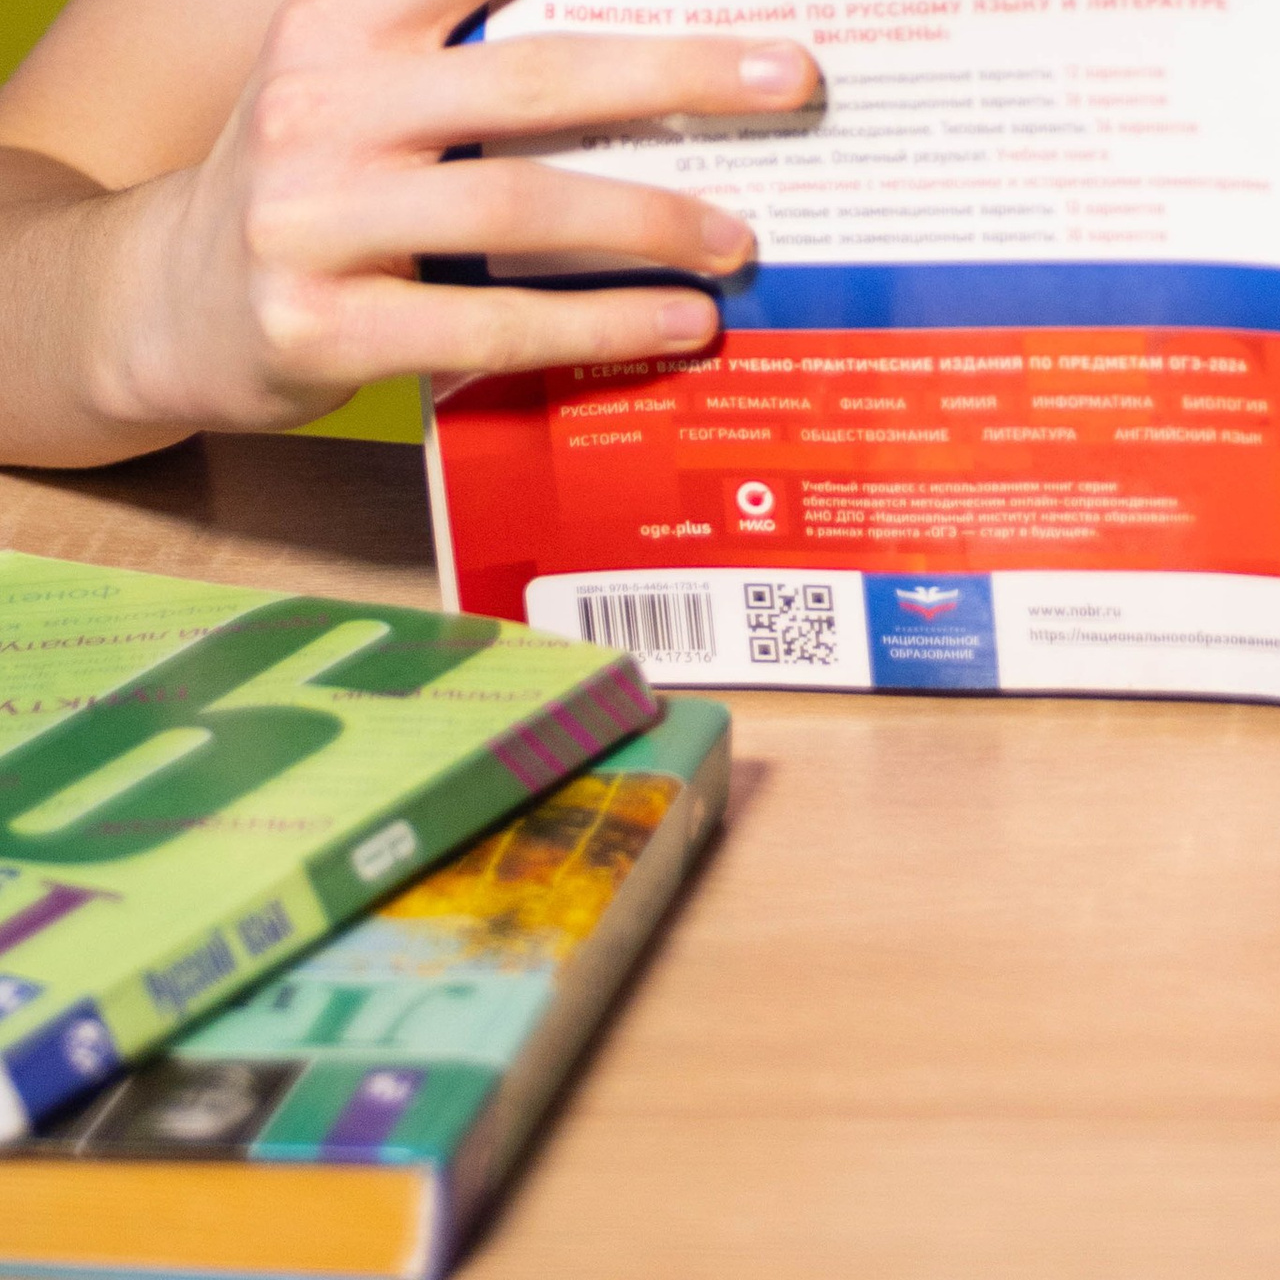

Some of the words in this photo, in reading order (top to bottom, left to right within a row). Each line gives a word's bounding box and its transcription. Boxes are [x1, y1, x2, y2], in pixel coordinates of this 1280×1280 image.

[544, 3, 556, 21] В
[564, 5, 675, 27] КОМПЛЕКТ
[684, 1, 797, 26] ИЗДАНИЙ
[807, 3, 836, 21] ПО
[846, 0, 963, 19] РУССКОМУ
[812, 26, 952, 46] ВКЛЮЧЕНЫ:
[573, 367, 584, 382] В
[591, 362, 649, 379] СЕРИЮ
[656, 357, 722, 374] ВХОДЯТ
[728, 356, 933, 374] УЧЕБНО-ПРАКТИЧЕСКИЕ
[938, 355, 1023, 374] ИЗДАНИЯ
[1029, 355, 1053, 372] ПО
[1058, 354, 1164, 373] ПРЕДМЕТАМ
[560, 398, 630, 418] РУССКИЙ
[634, 396, 677, 413] ЯЗЫК
[706, 396, 812, 411] МАТЕМАТИКА
[839, 395, 907, 411] ФИЗИКА
[940, 395, 998, 411] ХИМИЯ
[1031, 394, 1154, 411] ИНФОРМАТИКА
[1181, 394, 1269, 415] БИОЛОГИЯ
[568, 429, 643, 448] ИСТОРИЯ
[678, 426, 773, 442] ГЕОГРАФИЯ
[800, 427, 951, 444] ОБЩЕСТВОЗНАНИЕ
[981, 426, 1078, 443] ЛИТЕРАТУРА
[1113, 425, 1218, 444] АНГЛИЙСКИЙ
[1220, 429, 1264, 445] ЯЗЫК
[802, 480, 859, 495] Учебный
[862, 481, 916, 497] процесс
[930, 480, 1041, 495] использованием
[802, 495, 907, 510] обеспечивается
[804, 510, 833, 523] АНО
[836, 510, 866, 525] ДПО
[978, 511, 1038, 526] институт
[640, 520, 712, 539] oge.plus
[817, 527, 863, 541] рамках
[867, 526, 921, 541] проекта
[609, 582, 709, 593] 978-5-4454-1731-6
[1027, 603, 1122, 619] www.nobr.ru
[882, 634, 980, 649] НАЦИОНАЛЬНОЕ
[655, 651, 713, 663] 417316
[889, 648, 976, 661] ОБРАЗОВАНИЕ
